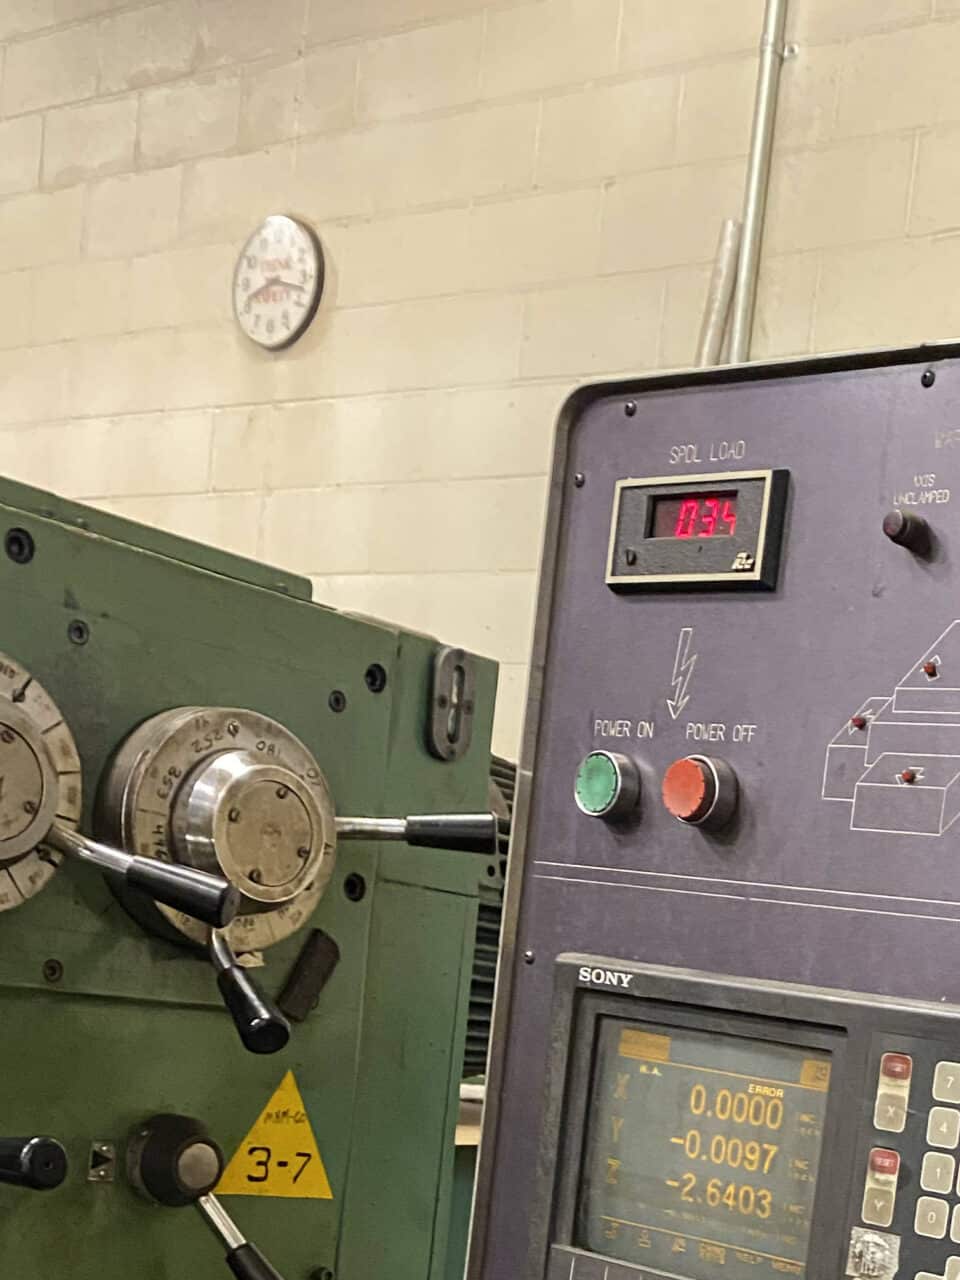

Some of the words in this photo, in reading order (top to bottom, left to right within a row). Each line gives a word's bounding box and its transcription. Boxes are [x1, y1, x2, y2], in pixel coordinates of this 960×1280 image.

[670, 441, 700, 465] SPDL
[594, 719, 634, 738] POWER
[637, 721, 654, 739] ON
[686, 723, 725, 741] POWER
[732, 724, 757, 741] OFF
[578, 967, 633, 988] SONY
[748, 1083, 785, 1099] ERROR
[946, 1076, 955, 1088] 7
[690, 1084, 784, 1130] 0.0000
[939, 1121, 948, 1134] 4
[669, 1130, 779, 1174] -0.0097
[246, 1146, 312, 1184] 3-7
[665, 1172, 774, 1219] -2.6403
